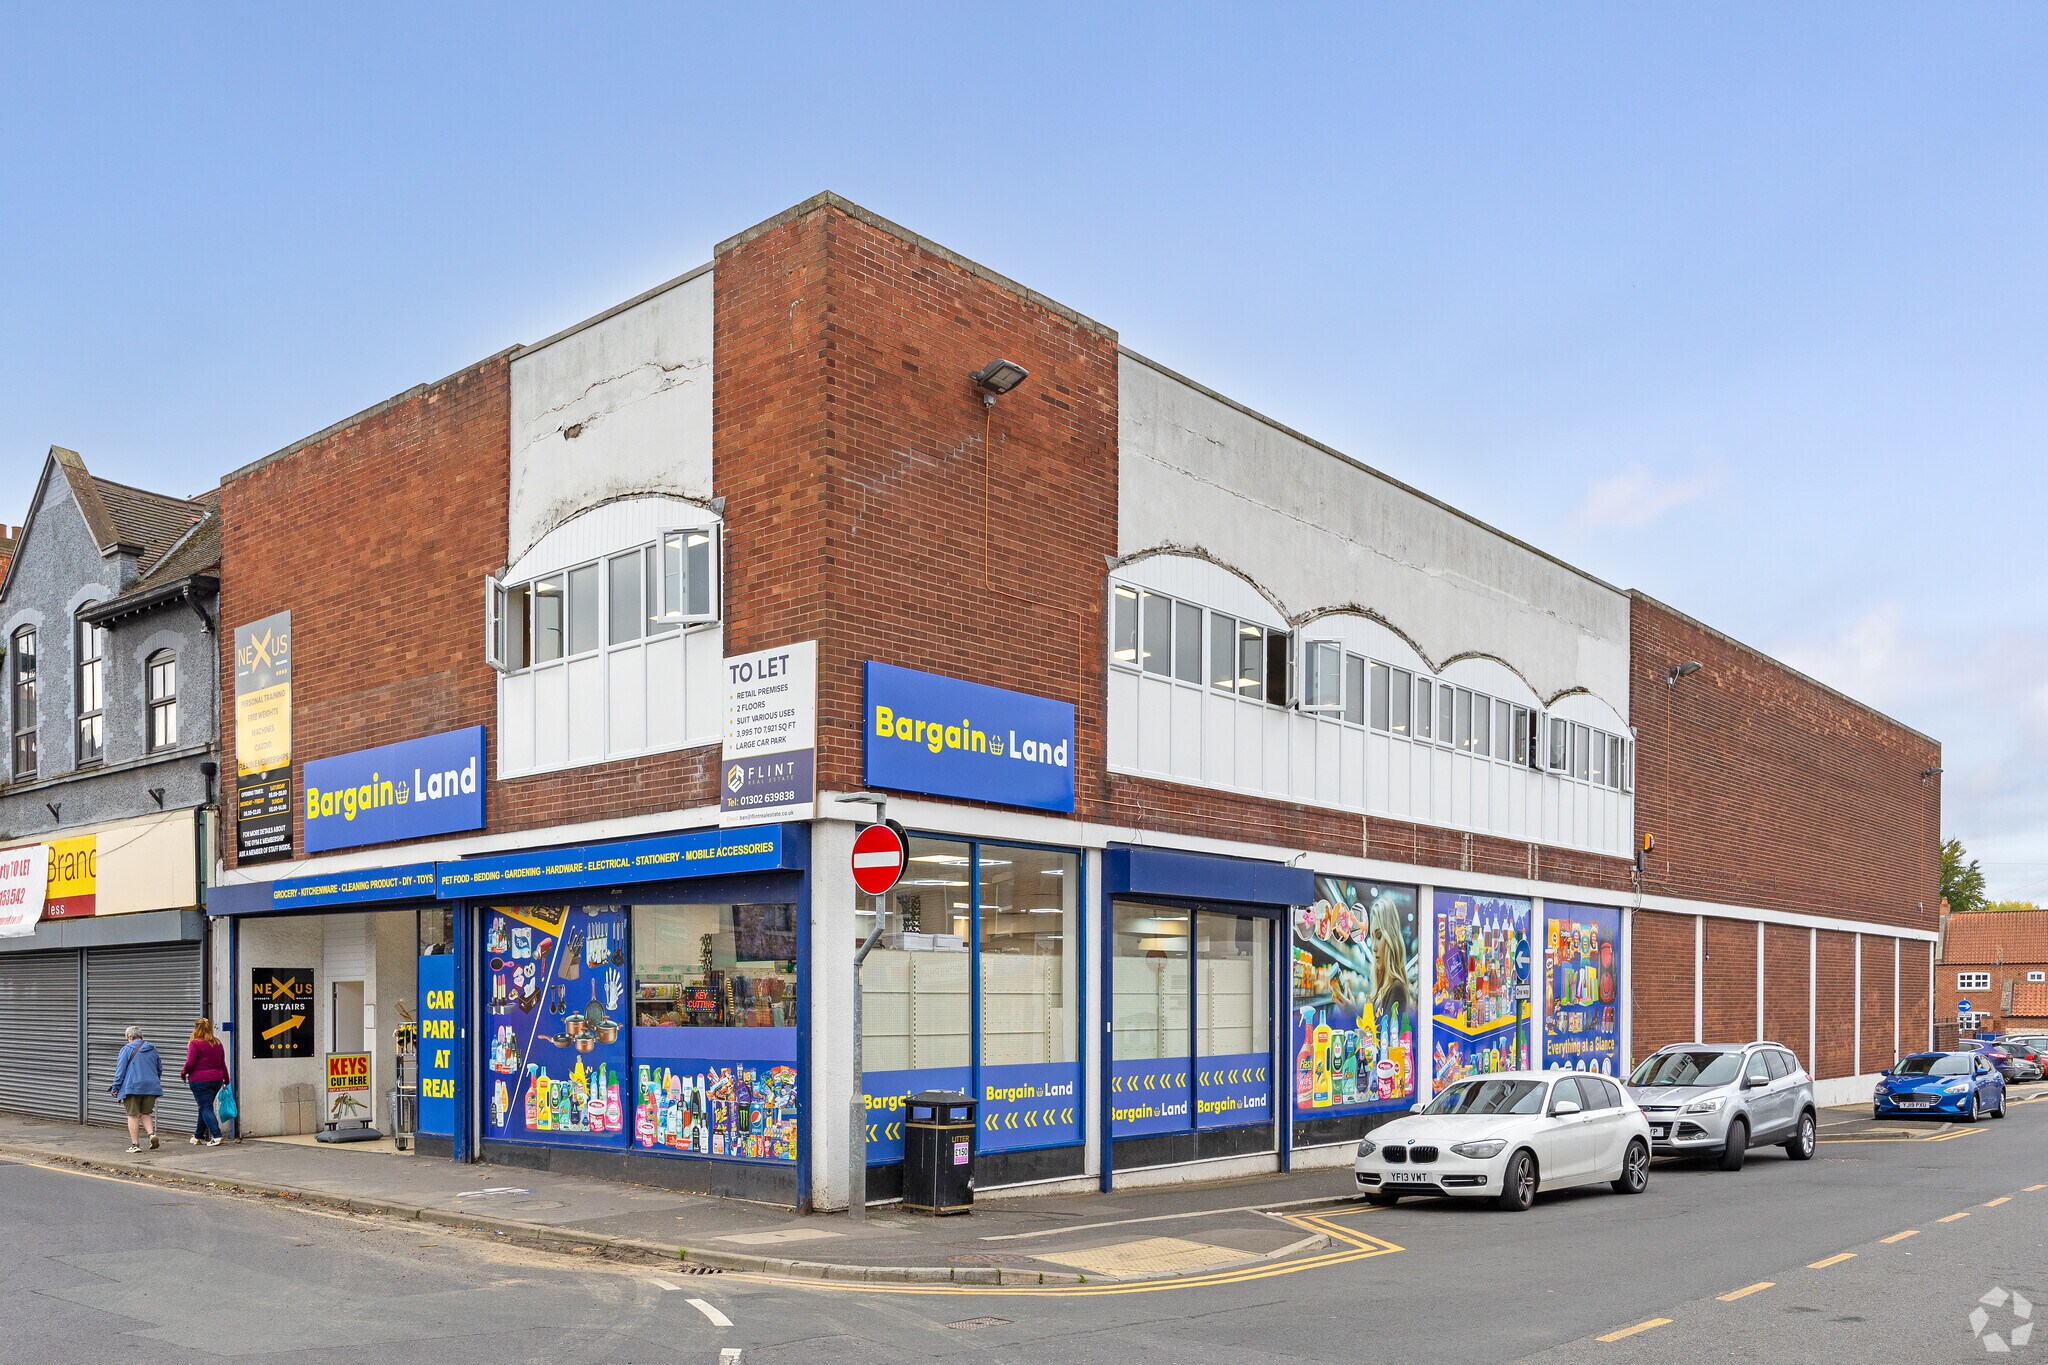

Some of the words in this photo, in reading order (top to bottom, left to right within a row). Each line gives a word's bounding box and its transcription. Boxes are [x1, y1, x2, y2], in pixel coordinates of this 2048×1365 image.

[238, 627, 288, 673] NEXUS
[729, 662, 752, 684] TO
[758, 654, 789, 679] LET
[241, 695, 263, 708] PERSONAL
[264, 690, 286, 702] TRAINING
[736, 690, 756, 700] RETAIL
[758, 684, 788, 696] PREMISES
[741, 701, 766, 711] FLOORS
[247, 712, 257, 722] FREE
[737, 716, 750, 725] SUIT
[752, 712, 777, 722] VARIOUS
[779, 708, 795, 718] USES
[737, 729, 752, 738] 3,995
[763, 725, 777, 734] 7,921
[778, 723, 787, 731] SQ
[788, 721, 796, 729] FT
[876, 705, 986, 754] Bargain
[1009, 730, 1067, 767] Land
[736, 740, 755, 750] LARGE
[756, 738, 769, 747] CAR
[770, 736, 786, 745] PARK
[748, 762, 794, 779] FLINT
[769, 775, 794, 783] ESTATE
[307, 772, 393, 821] Bargain
[414, 756, 476, 802] Land
[727, 798, 739, 807] Tel:
[740, 795, 763, 805] 01302
[765, 791, 794, 802] 639838
[20, 859, 30, 876] LET
[442, 876, 452, 885] PET
[454, 874, 470, 883] FOOD
[474, 871, 500, 882] BEDDING
[504, 867, 540, 878] GARDENING
[545, 863, 583, 874] HARDWARE
[588, 858, 630, 870] ELECTRICAL
[635, 852, 680, 866] STATIONERY
[685, 848, 715, 860] MOBILE
[716, 842, 774, 857] ACCESSORIES
[274, 888, 298, 899] GROCERY
[301, 884, 338, 896] KITCHENWARE
[342, 881, 369, 892] CLEANING
[371, 878, 398, 889] PRODUCT
[402, 876, 412, 886] DIY
[416, 874, 434, 884] TOYS
[48, 904, 64, 915] less
[254, 976, 312, 1000] NEXUS
[695, 992, 708, 1000] KEY
[262, 1003, 305, 1011] UPSTAIRS
[427, 990, 454, 1009] CAR
[1548, 1039, 1580, 1058] Everything
[1582, 1038, 1588, 1052] at
[1590, 1040, 1593, 1051] a
[1596, 1036, 1614, 1051] Glance
[330, 1057, 367, 1075] KEYS
[434, 1050, 450, 1068] AT
[331, 1077, 346, 1086] CUT
[348, 1076, 367, 1085] HERE
[986, 1082, 1035, 1102] Bargain
[1044, 1081, 1073, 1096] Land
[863, 1090, 911, 1111] Barga
[1162, 1101, 1187, 1116] Land
[1198, 1096, 1236, 1115] Bargain
[1243, 1093, 1266, 1108] Land
[952, 1135, 969, 1143] LITTER
[1391, 1173, 1408, 1181] YF13
[1411, 1173, 1427, 1181] VWT
